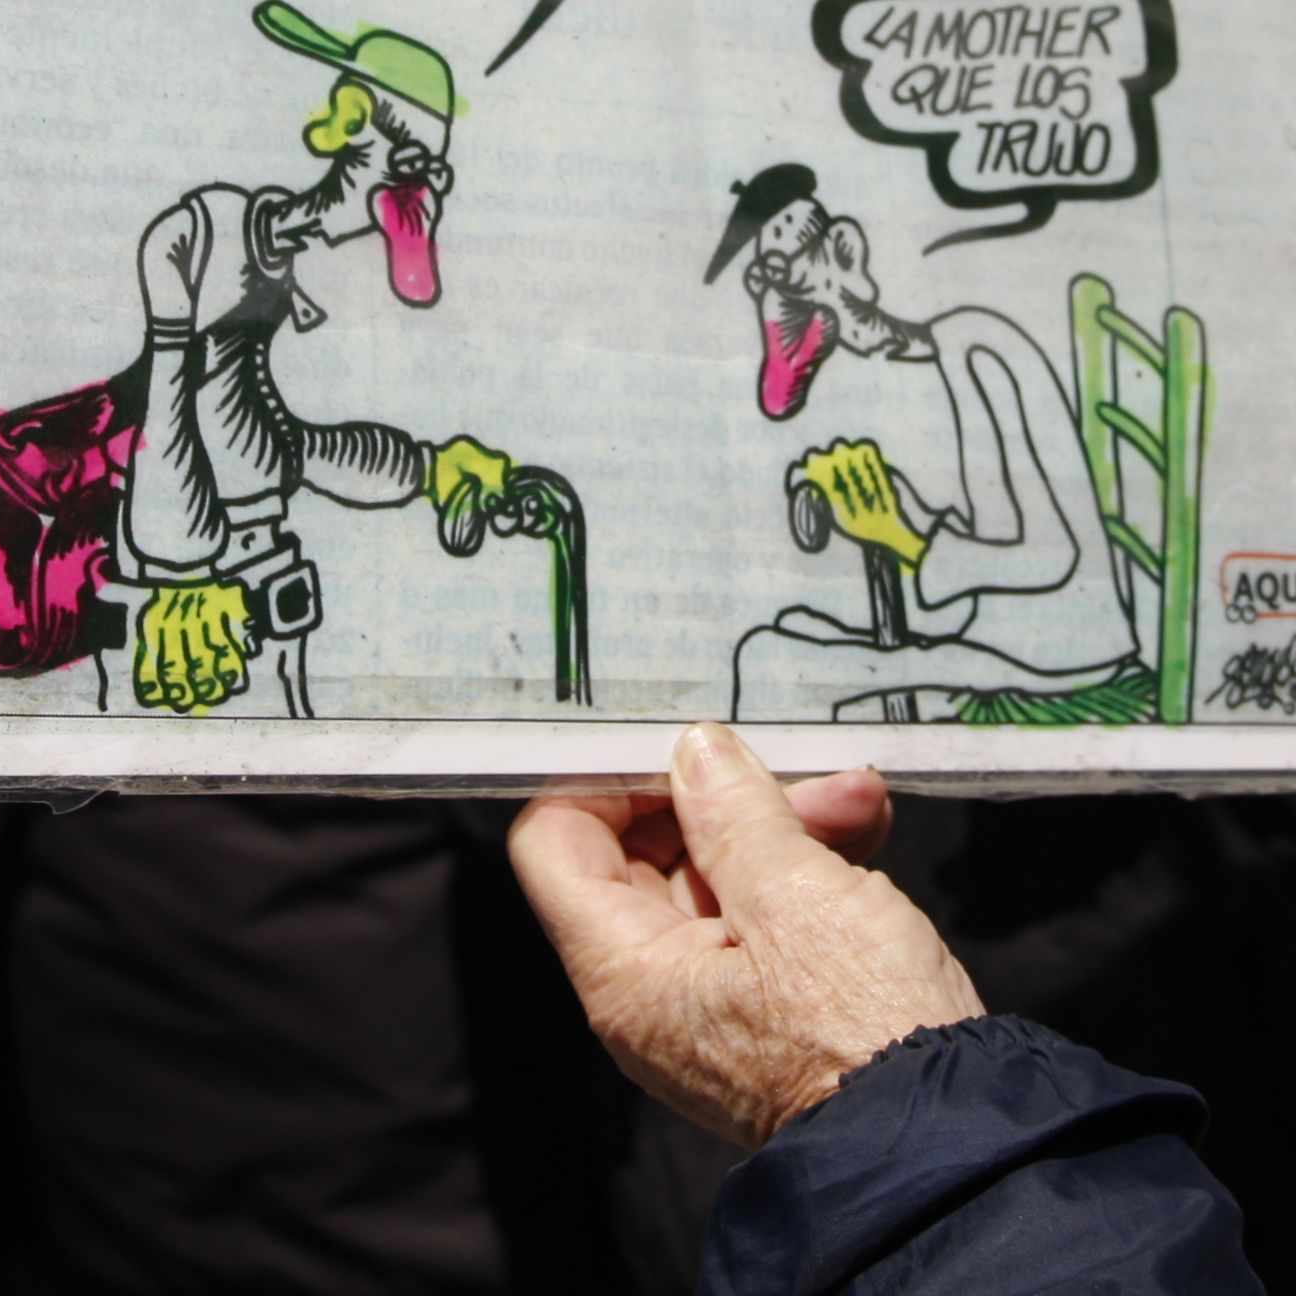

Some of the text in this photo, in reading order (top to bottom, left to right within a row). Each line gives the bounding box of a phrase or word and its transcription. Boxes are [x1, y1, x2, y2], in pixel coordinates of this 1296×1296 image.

[863, 4, 1122, 61] LA MOTHER
[891, 63, 1092, 121] QUE LOS
[976, 120, 1112, 177] TRUJO
